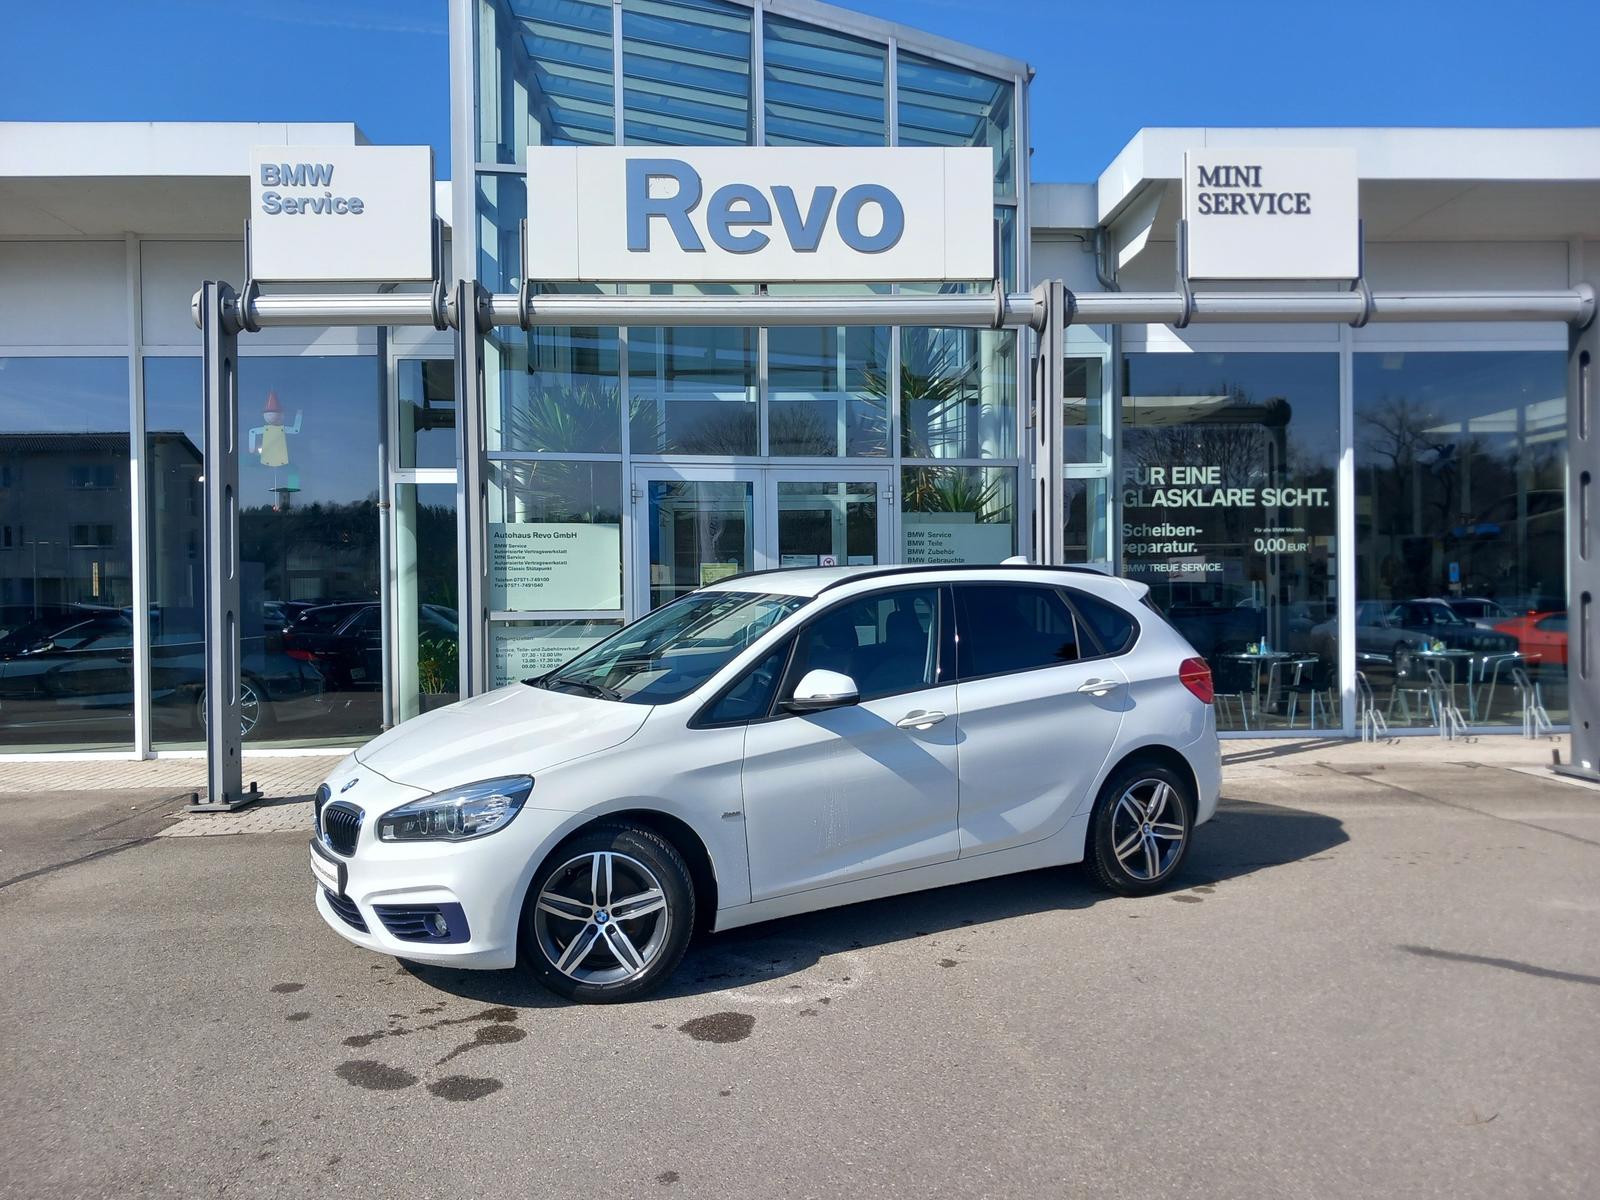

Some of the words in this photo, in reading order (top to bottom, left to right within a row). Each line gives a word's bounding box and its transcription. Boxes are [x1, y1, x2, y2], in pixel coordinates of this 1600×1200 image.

[260, 163, 334, 187] BMW
[1197, 166, 1262, 188] MINI
[262, 190, 365, 215] Service
[625, 158, 905, 254] Revo
[1198, 192, 1312, 215] SERVICE
[1122, 463, 1165, 485] FÜR
[1172, 466, 1221, 485] EINE
[1122, 488, 1256, 508] GLASKLARE
[1261, 488, 1329, 507] SICHT.
[1122, 523, 1203, 537] Scheiben-
[1122, 540, 1198, 556] reparatur.
[1254, 538, 1286, 555] 0,00
[1122, 564, 1146, 572] BMW
[1149, 563, 1178, 572] TREUE
[1181, 563, 1224, 572] SERVICE.
